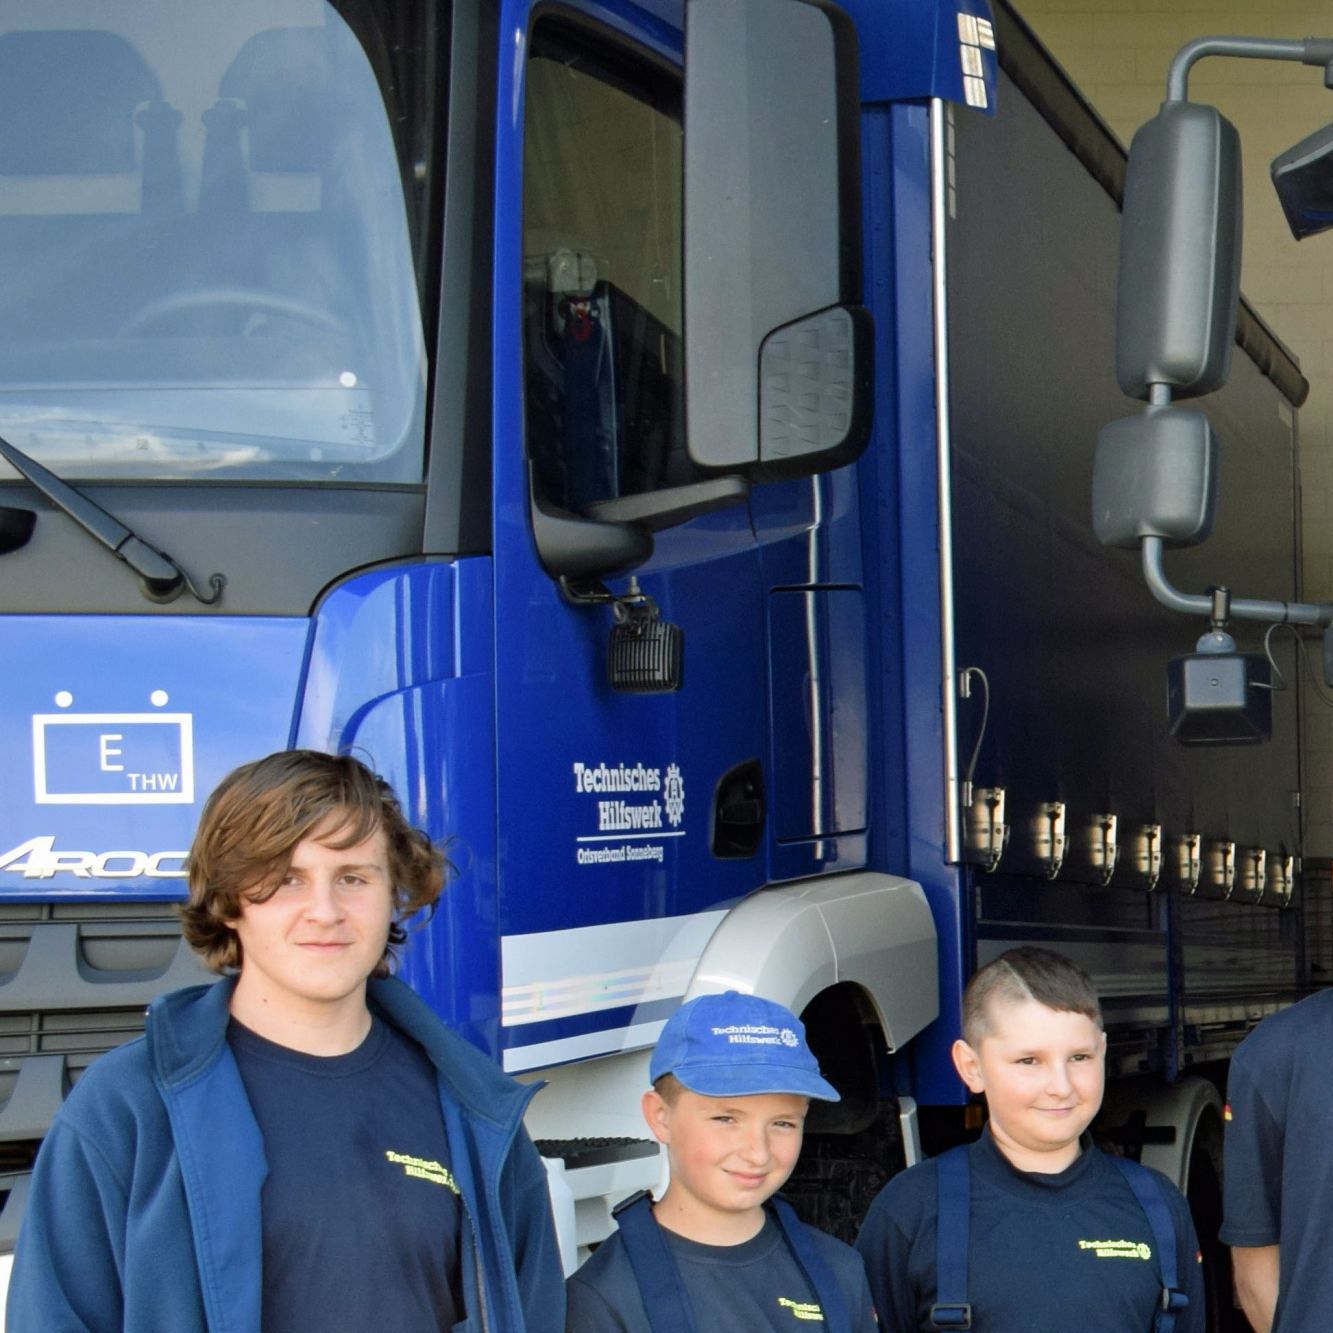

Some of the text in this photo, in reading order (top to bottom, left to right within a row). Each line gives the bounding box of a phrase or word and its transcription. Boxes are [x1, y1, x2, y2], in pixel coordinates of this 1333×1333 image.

[100, 734, 124, 771] E
[127, 773, 178, 791] THW
[573, 762, 661, 793] Technisches
[598, 799, 663, 831] Hilfswerk
[711, 1024, 780, 1036] Technisches
